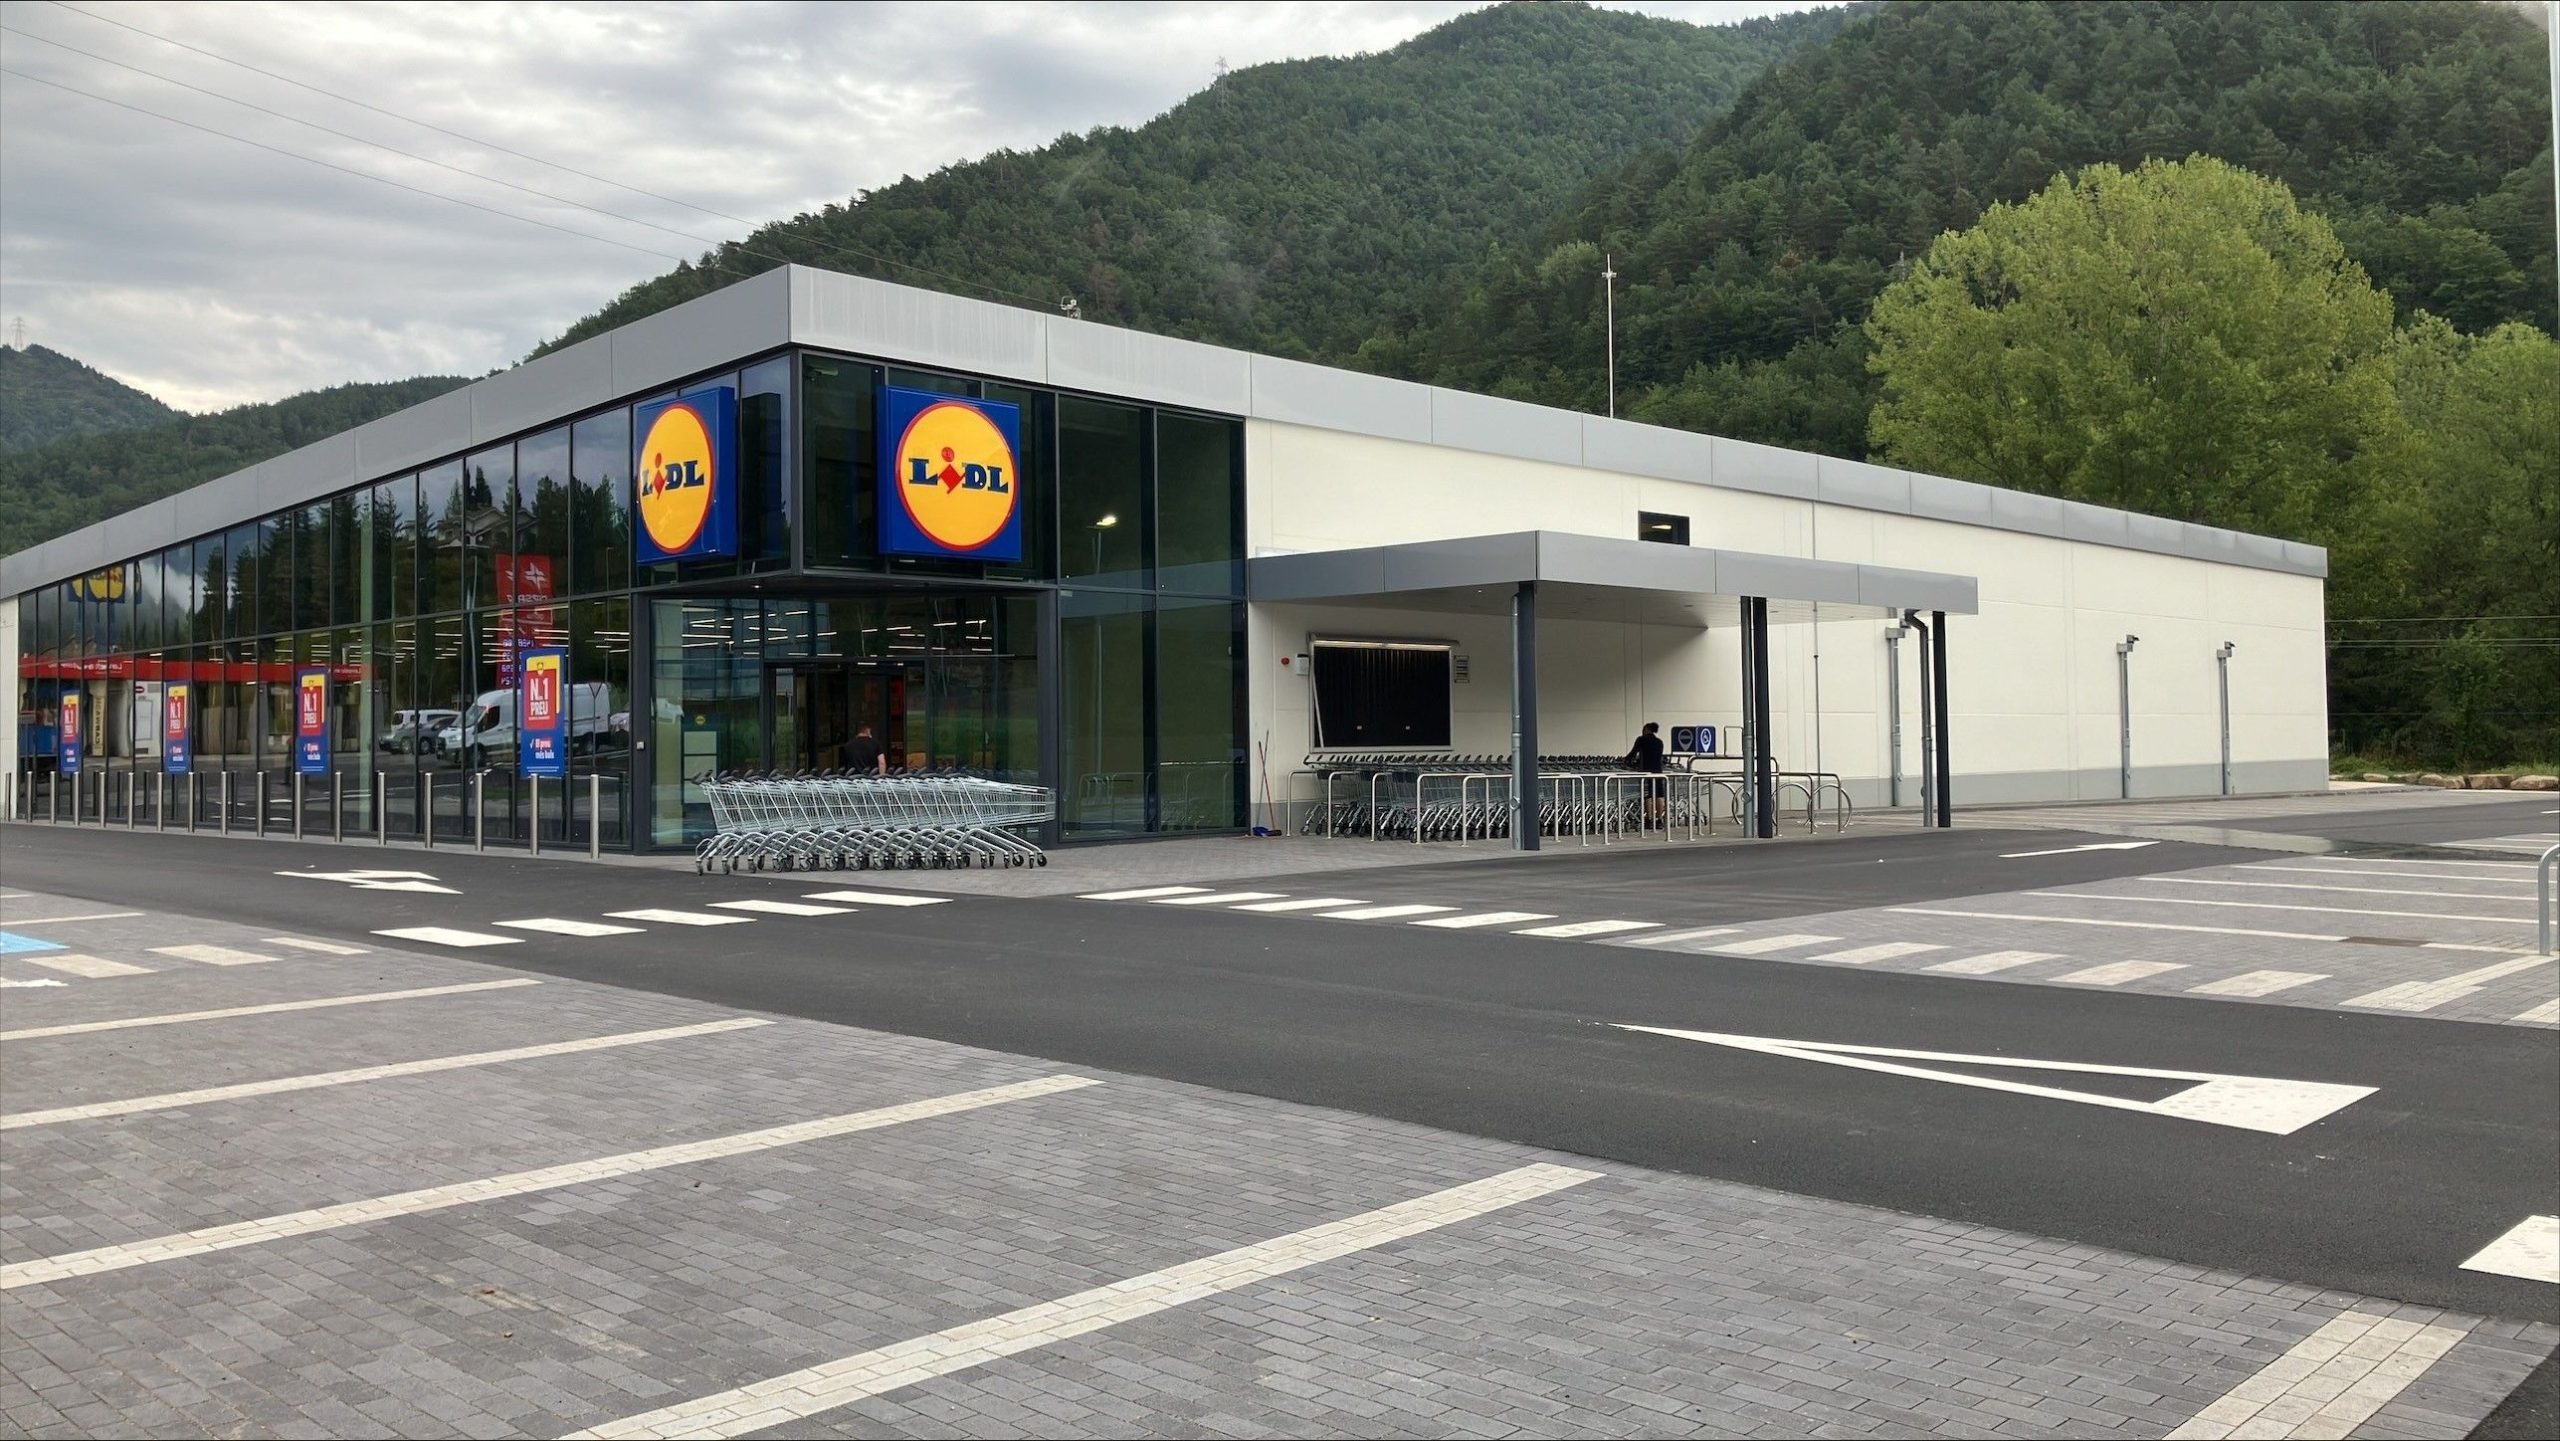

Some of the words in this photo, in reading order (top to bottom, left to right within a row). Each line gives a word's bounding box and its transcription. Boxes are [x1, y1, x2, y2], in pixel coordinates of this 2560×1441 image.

[530, 678, 549, 700] N.1
[304, 693, 318, 712] N.1
[529, 701, 549, 716] PREU
